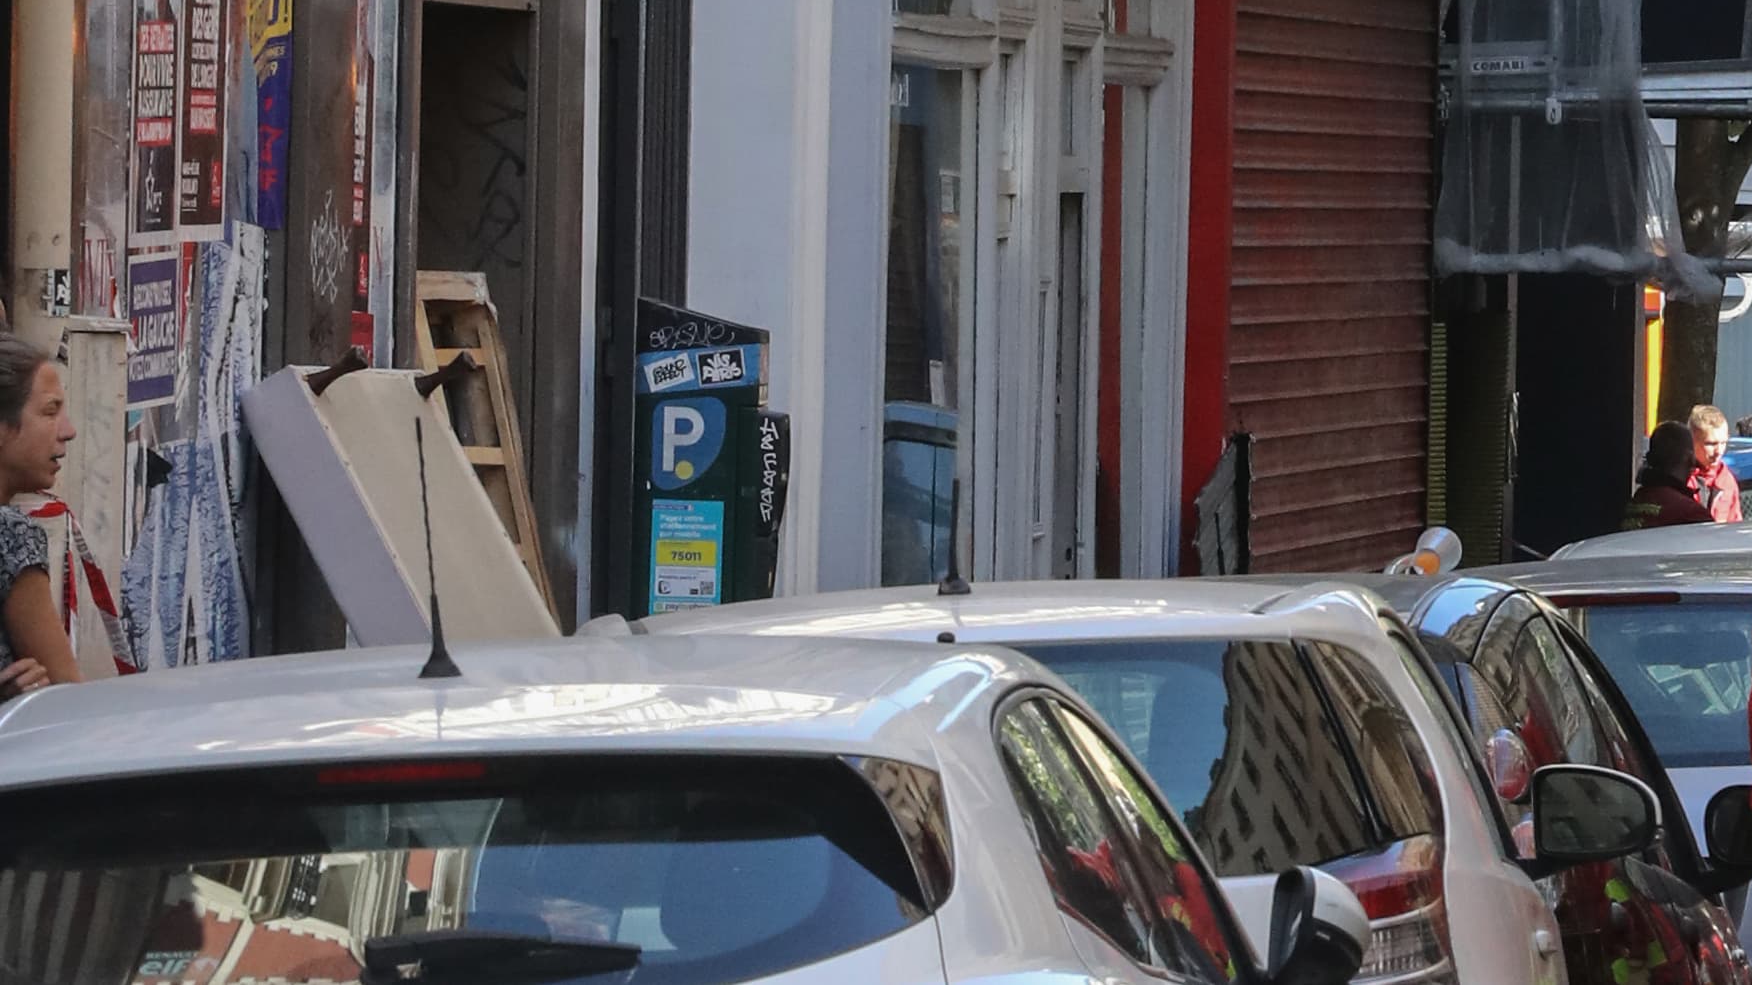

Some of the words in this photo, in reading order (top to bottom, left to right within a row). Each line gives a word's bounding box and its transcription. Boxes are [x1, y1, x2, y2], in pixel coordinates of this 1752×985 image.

[663, 406, 705, 472] P
[671, 550, 703, 562] 75011
[138, 958, 190, 975] elf
